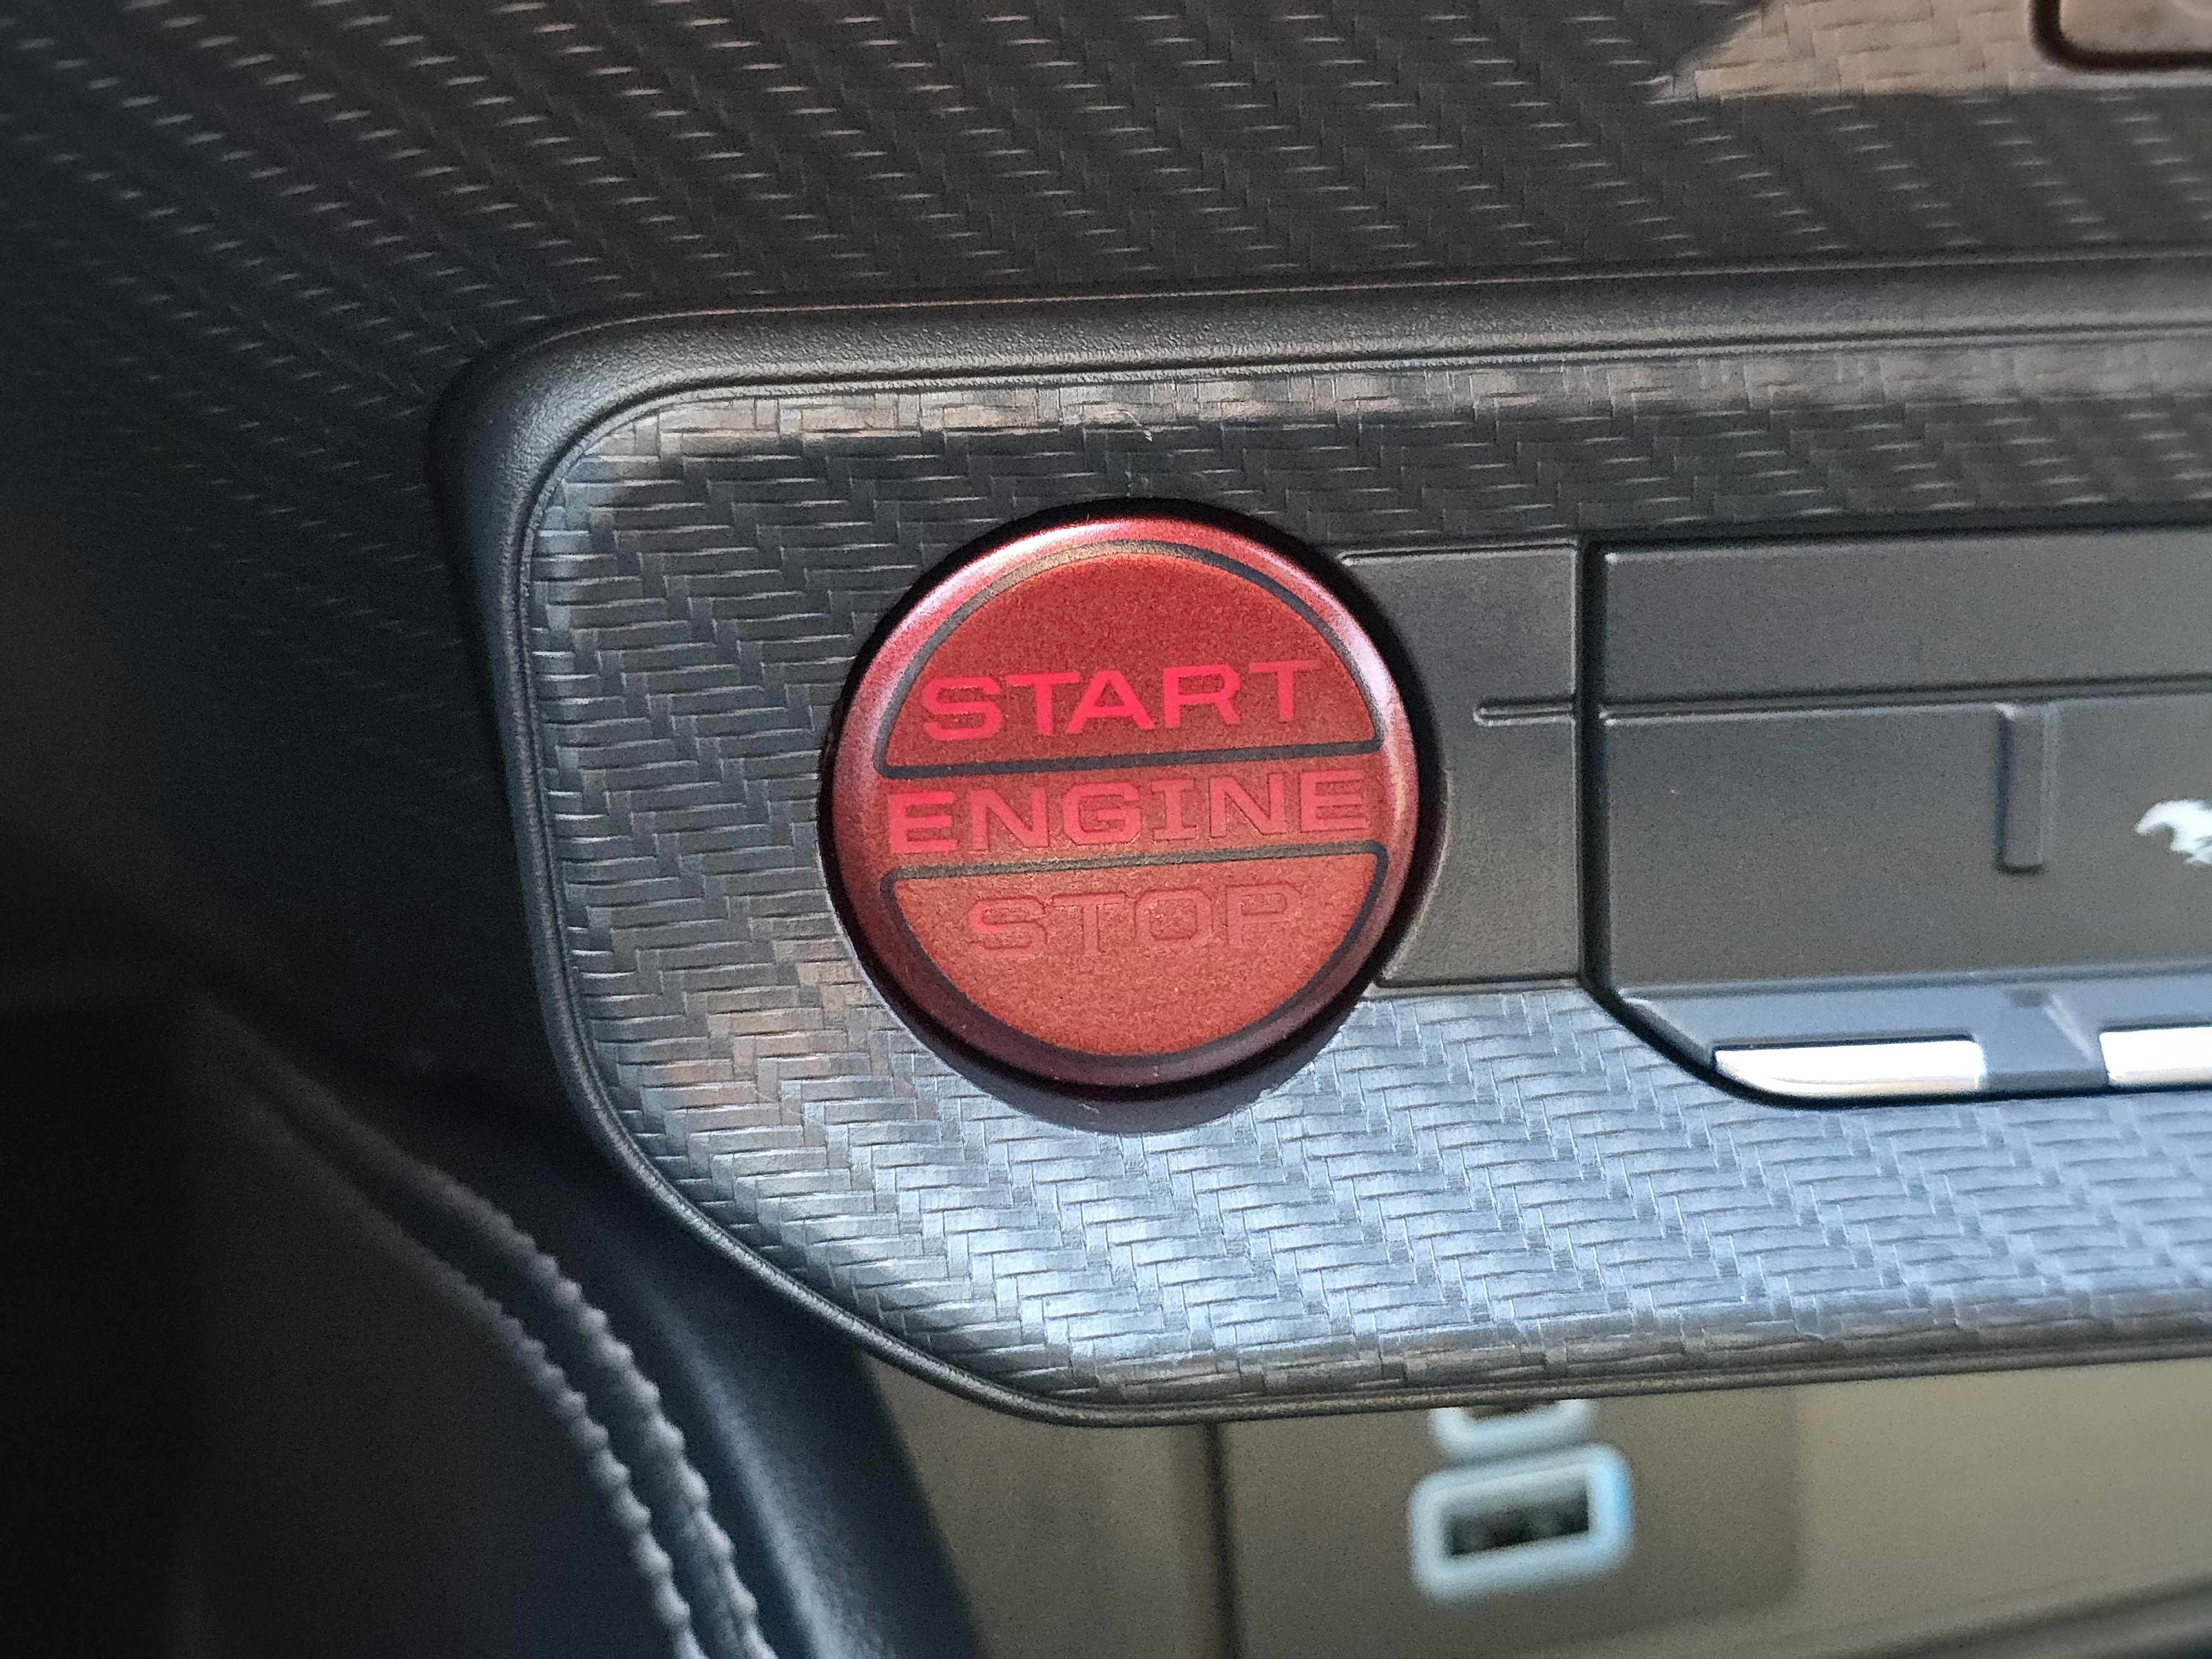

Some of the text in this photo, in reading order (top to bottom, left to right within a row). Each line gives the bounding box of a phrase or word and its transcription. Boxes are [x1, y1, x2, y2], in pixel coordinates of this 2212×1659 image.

[920, 659, 1322, 741] START
[887, 769, 1370, 855] ENGINE
[969, 883, 1303, 960] STOP
